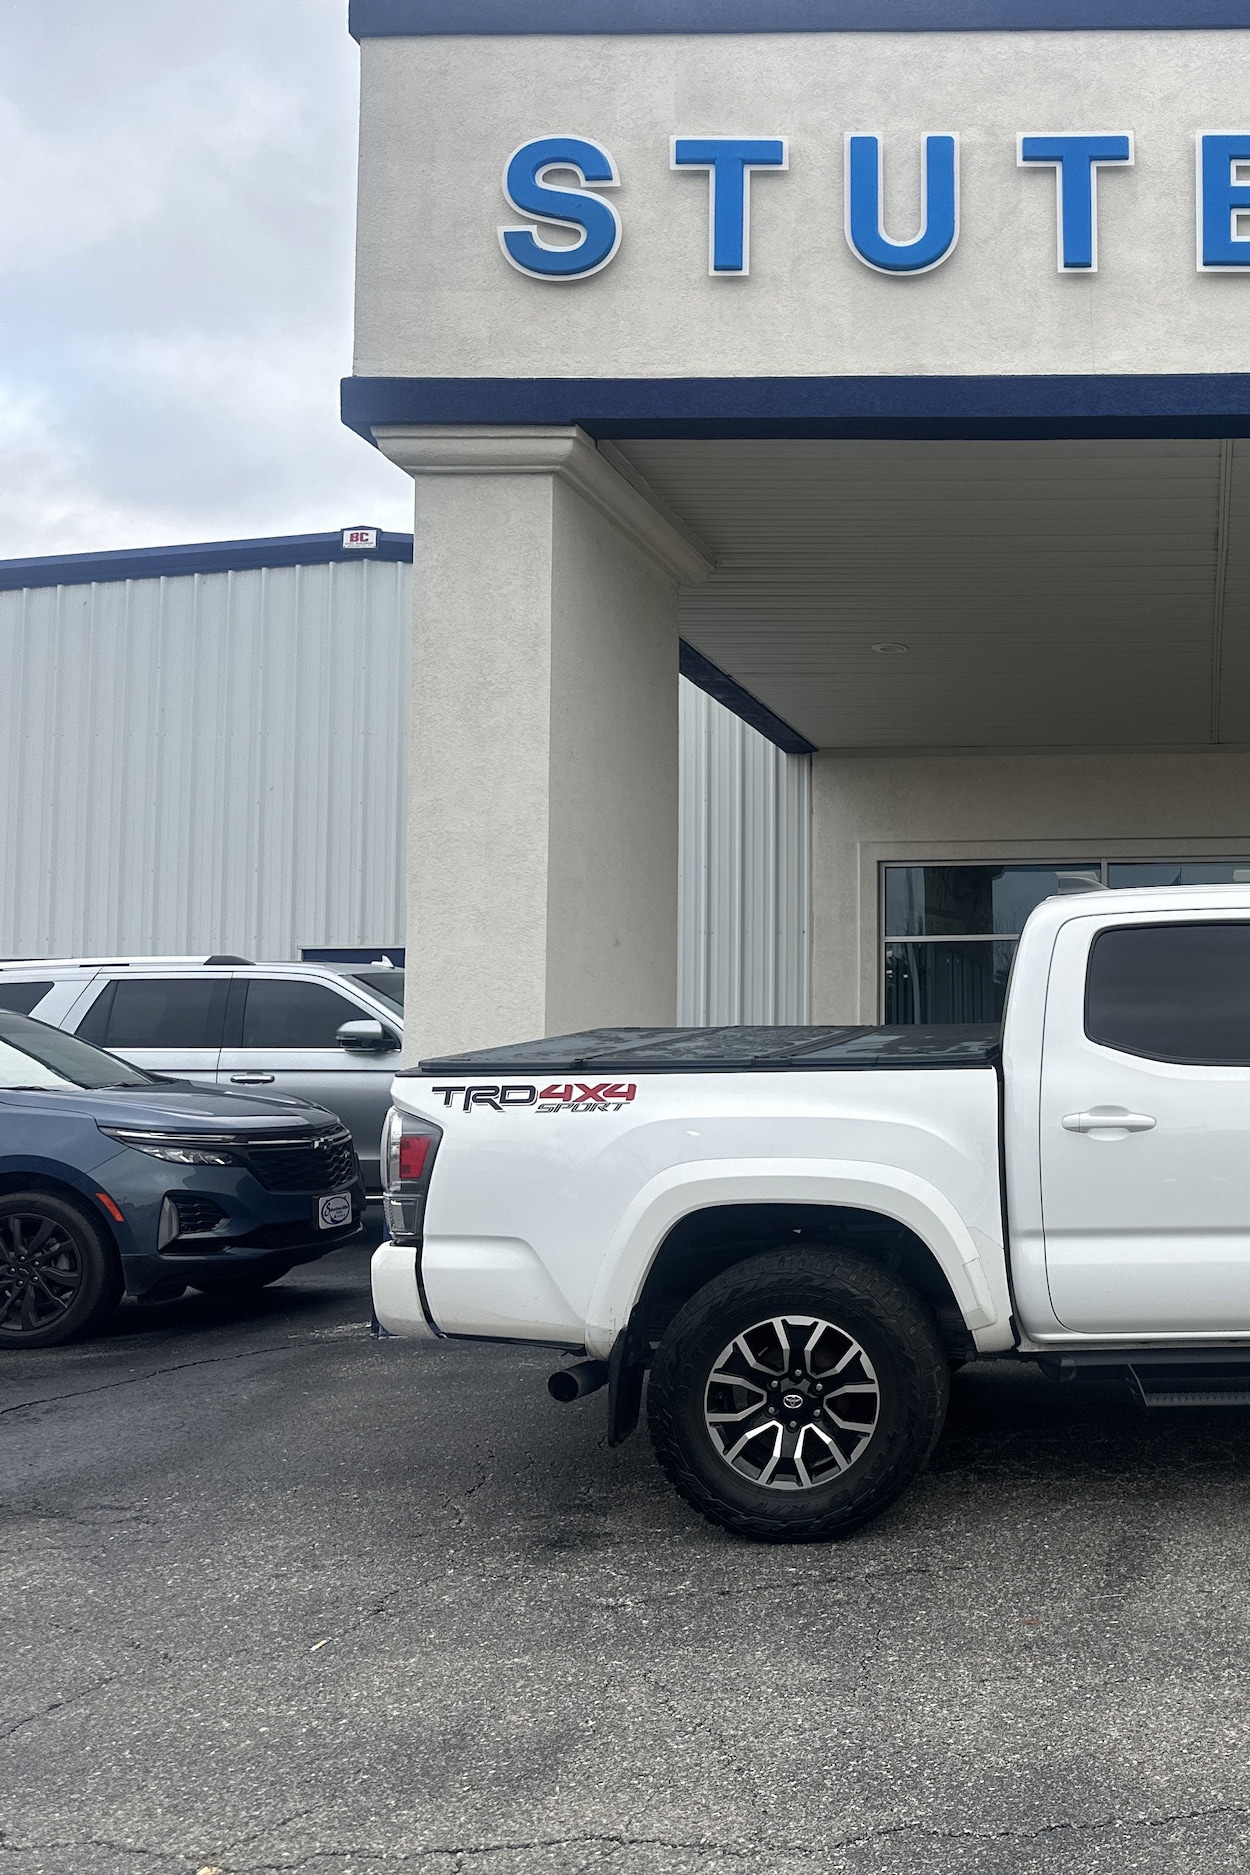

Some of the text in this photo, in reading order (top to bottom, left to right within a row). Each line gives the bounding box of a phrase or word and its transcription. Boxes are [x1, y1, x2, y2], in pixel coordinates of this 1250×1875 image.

[350, 532, 369, 542] BC
[432, 1085, 538, 1113] TRD
[535, 1101, 631, 1113] SPORT
